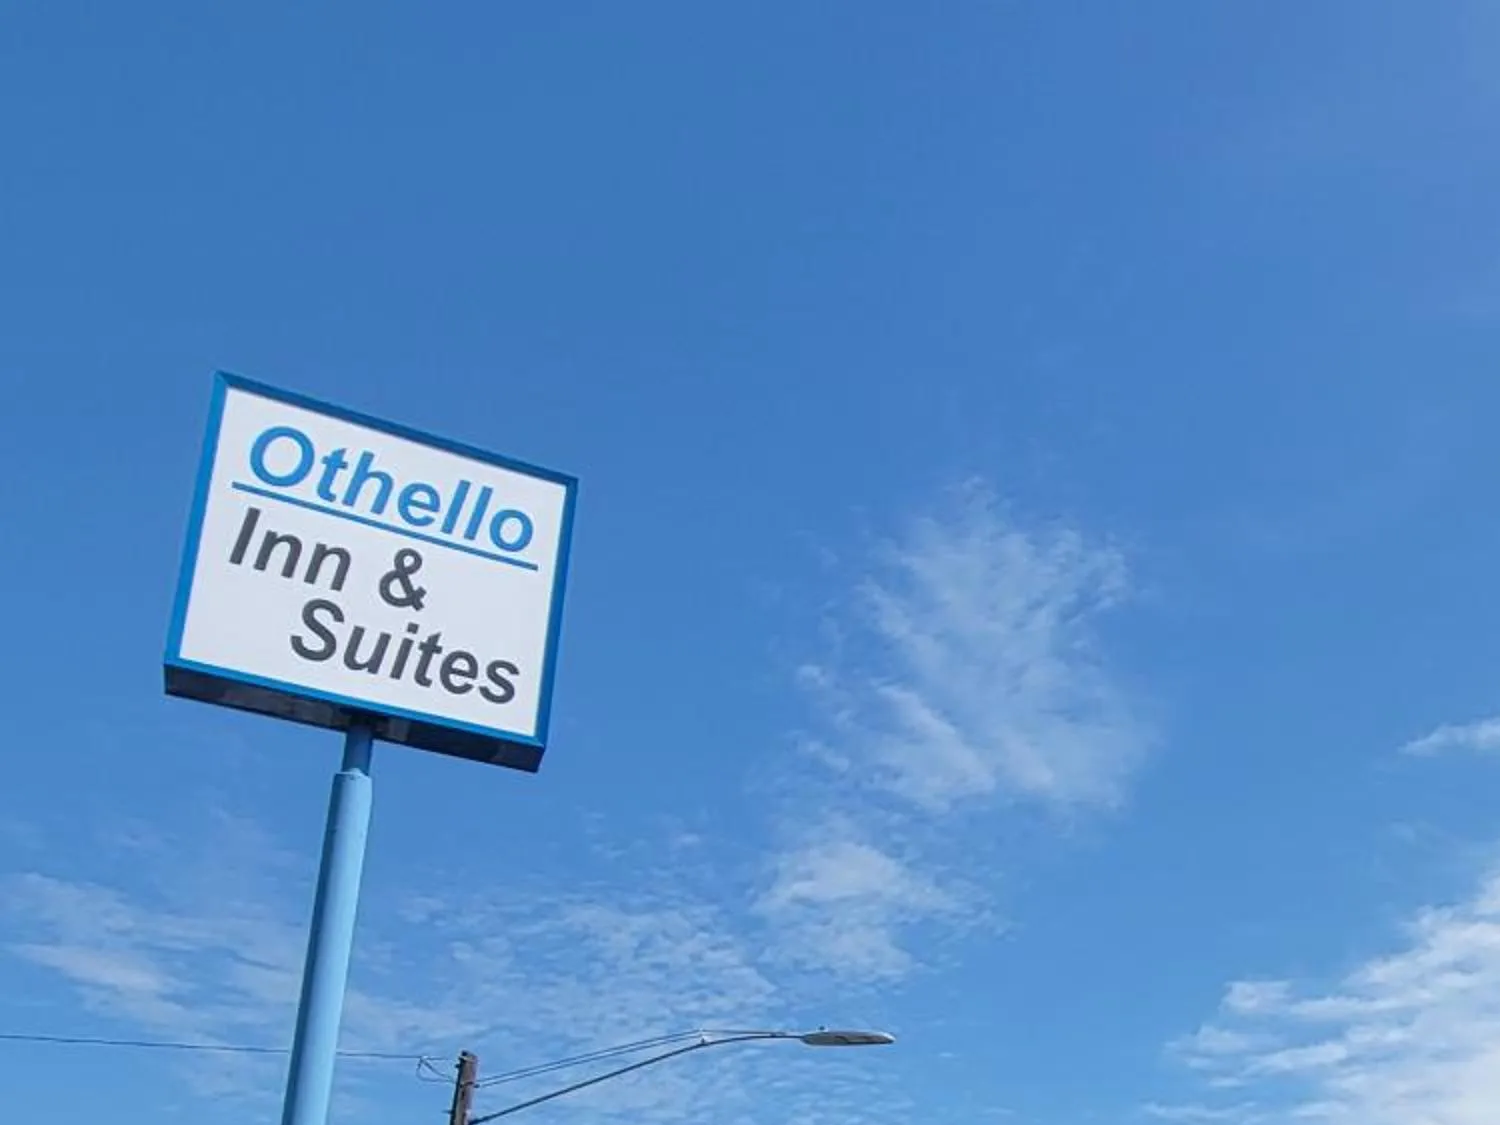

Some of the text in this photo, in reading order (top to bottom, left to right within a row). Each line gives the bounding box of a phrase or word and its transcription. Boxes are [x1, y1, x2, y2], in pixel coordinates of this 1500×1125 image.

[250, 425, 534, 553] Othello
[229, 507, 428, 612] Inn &
[290, 598, 521, 705] Suites
